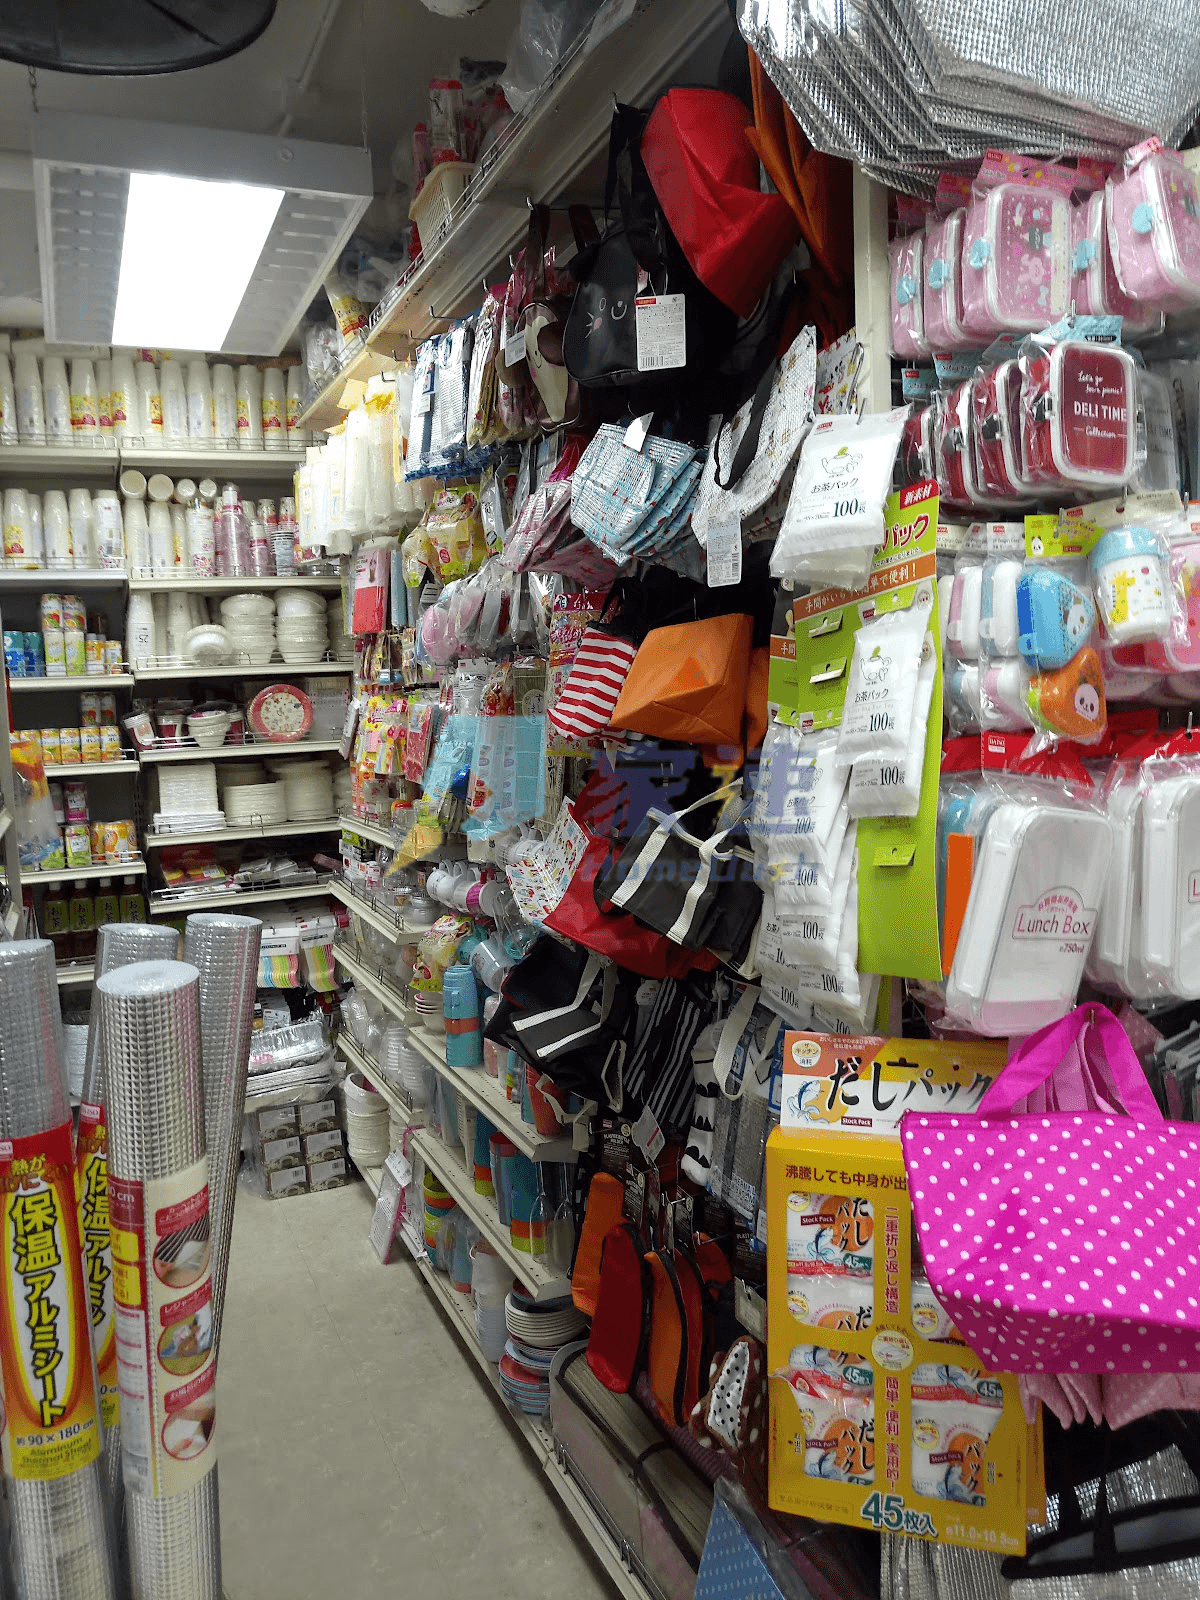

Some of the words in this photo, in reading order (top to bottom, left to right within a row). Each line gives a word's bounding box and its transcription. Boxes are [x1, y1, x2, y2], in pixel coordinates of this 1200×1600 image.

[1074, 401, 1098, 419] DELI
[1102, 405, 1127, 422] TIME
[1086, 425, 1116, 439] Collection
[811, 477, 859, 494] お茶パック
[904, 483, 932, 506] 新素材
[855, 689, 889, 703] お茶パック
[1017, 913, 1059, 934] Lunch
[1062, 915, 1090, 935] Box
[827, 1056, 993, 1112] だしパック
[842, 1117, 856, 1125] Stock
[858, 1119, 871, 1127] Pack
[12, 1153, 46, 1176] 熱が
[117, 1193, 134, 1203] cm
[836, 1200, 851, 1252] パック
[885, 1206, 899, 1314] 二重折り返し構造
[9, 1189, 66, 1428] 保温アルミシート
[27, 1435, 43, 1446] 90
[60, 1423, 80, 1440] 180
[83, 1418, 94, 1430] cm
[841, 1426, 856, 1474] パック
[861, 1491, 938, 1537] 45枚入
